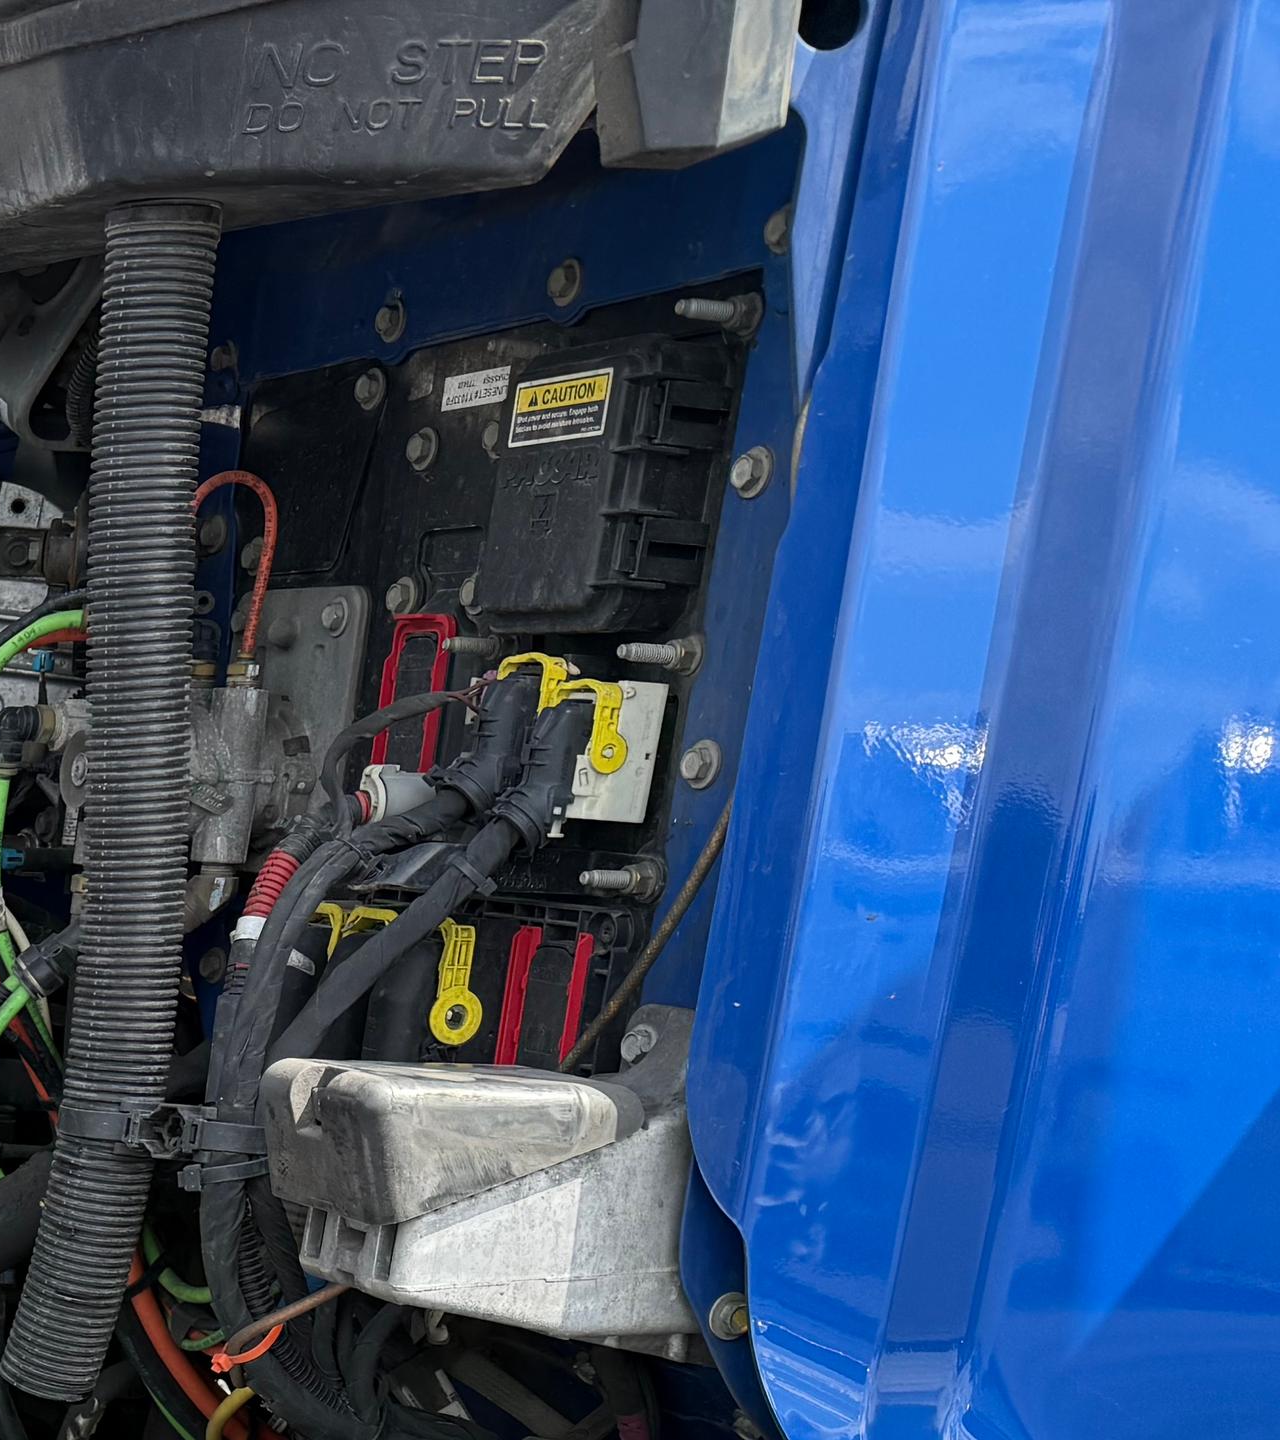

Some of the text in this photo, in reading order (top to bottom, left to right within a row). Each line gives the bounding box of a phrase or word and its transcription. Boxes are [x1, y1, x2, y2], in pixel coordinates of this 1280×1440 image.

[252, 39, 548, 89] NO STEP
[242, 98, 549, 135] DO NOT PULL
[542, 381, 596, 405] CAUTION
